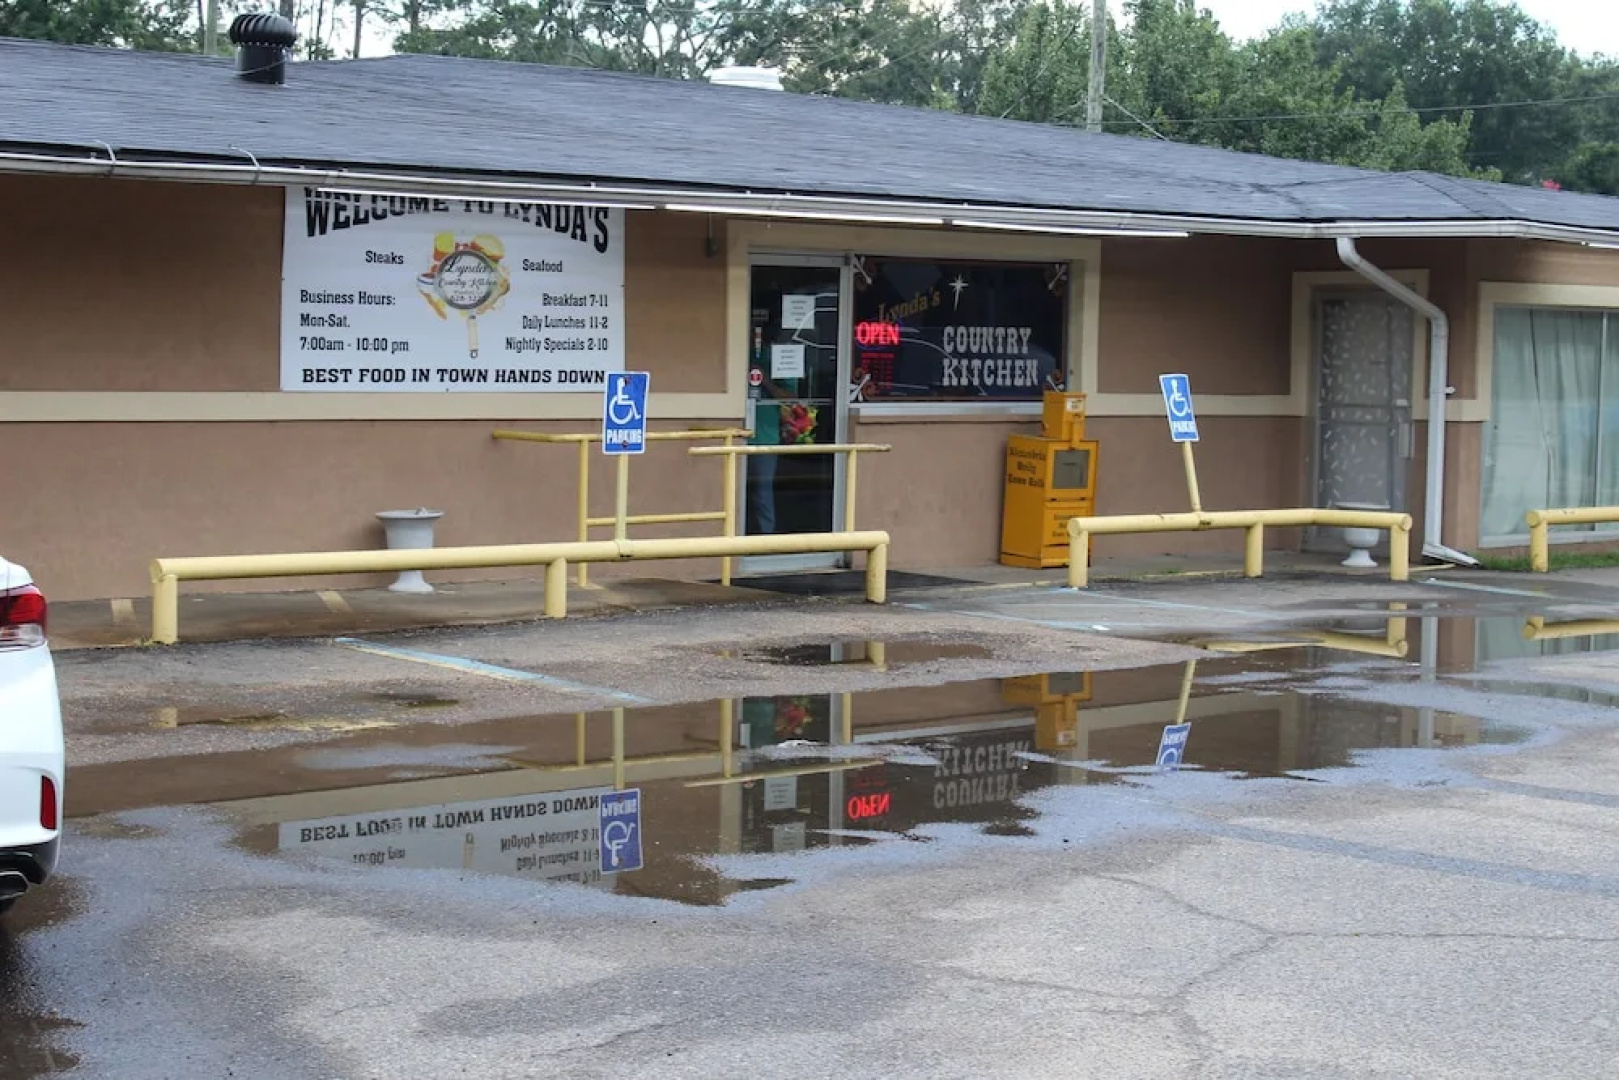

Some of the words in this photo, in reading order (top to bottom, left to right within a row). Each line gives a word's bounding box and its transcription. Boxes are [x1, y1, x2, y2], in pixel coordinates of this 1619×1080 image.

[304, 186, 449, 237] WELCOME
[505, 202, 609, 253] LYNDA'S
[365, 250, 404, 265] Steaks
[522, 258, 563, 272] Seafood
[300, 289, 354, 304] Business
[358, 291, 396, 305] Hours:
[542, 293, 587, 306] Breakfast
[589, 294, 608, 306] 7-11
[300, 313, 350, 327] Mon-Sat.
[522, 315, 543, 332] Daily
[544, 315, 585, 329] Lunches
[589, 316, 608, 329] 11-2
[856, 321, 900, 345] OPEN
[943, 325, 1031, 354] COUNTRY
[299, 336, 344, 351] 7:00am
[356, 337, 387, 351] 10:00
[391, 340, 409, 354] pm
[505, 336, 541, 353] Nightly
[543, 337, 585, 353] Specials
[587, 337, 608, 350] 2-10
[302, 368, 353, 383] BEST
[358, 368, 406, 383] FOOD
[411, 368, 430, 382] IN
[436, 368, 488, 383] TOWN
[494, 369, 552, 383] HANDS
[557, 370, 605, 384] DOWN
[942, 358, 1038, 386] KITCHEN
[606, 428, 642, 445] PARKING
